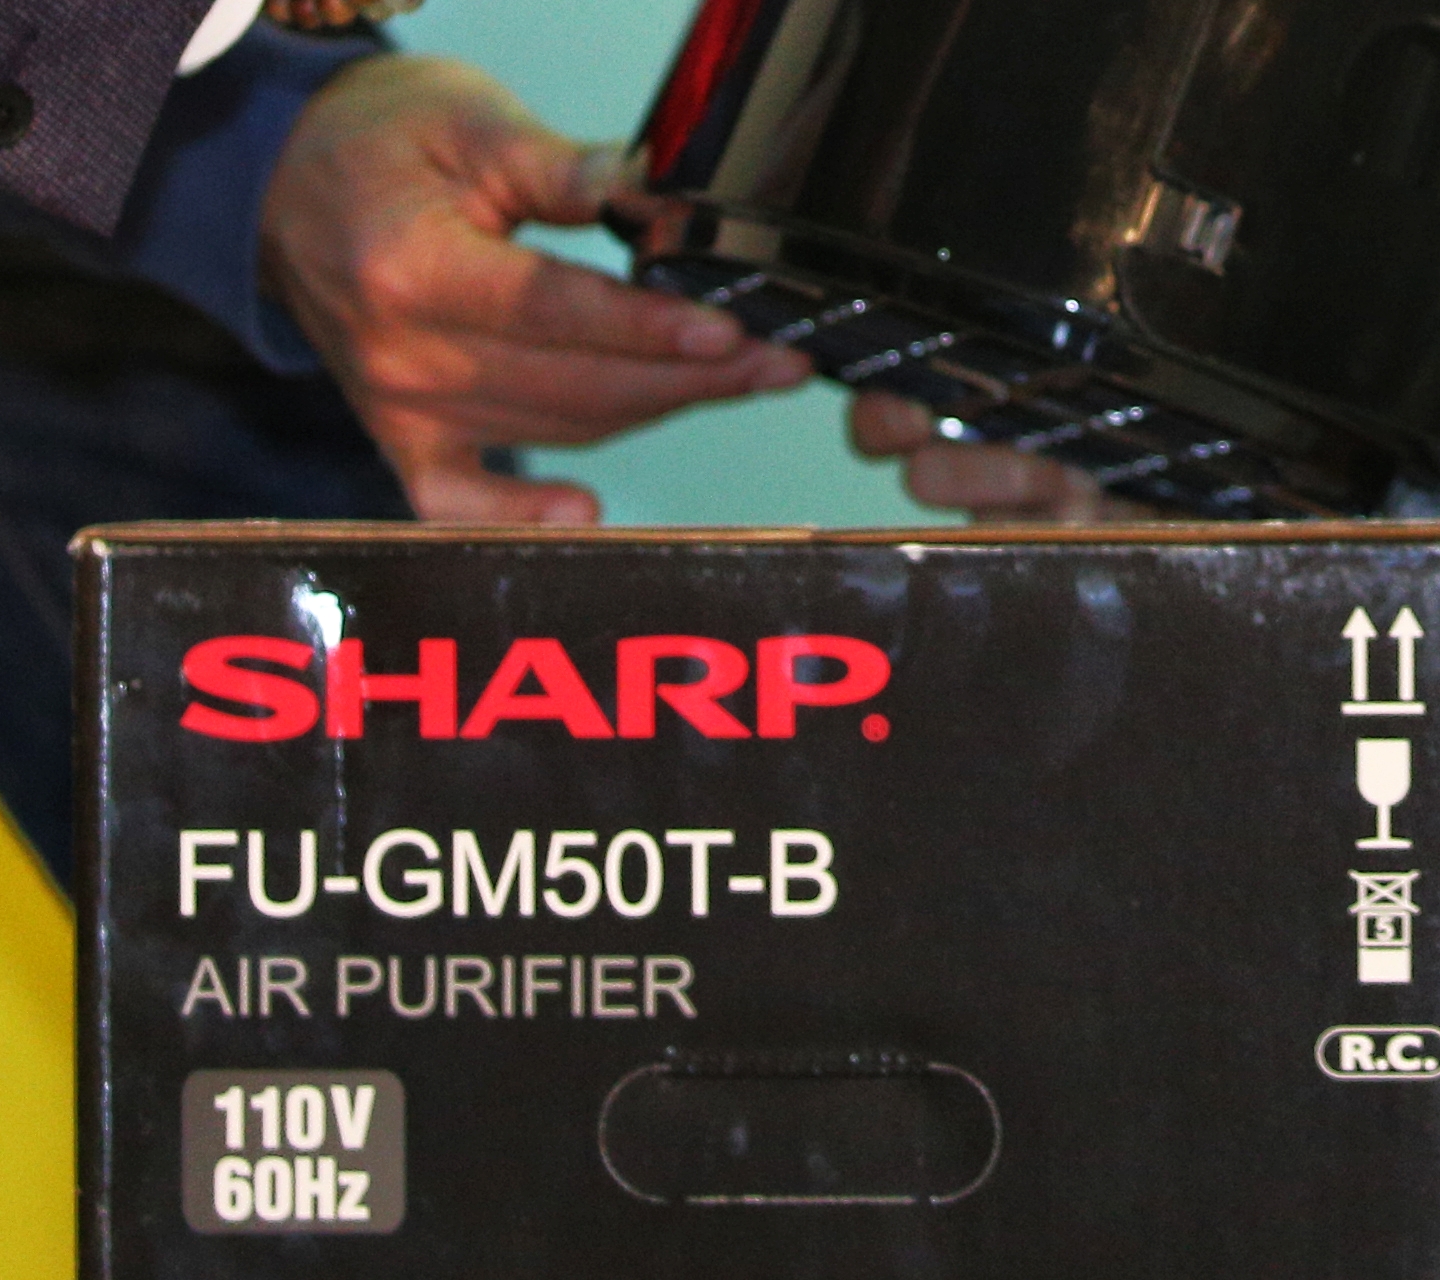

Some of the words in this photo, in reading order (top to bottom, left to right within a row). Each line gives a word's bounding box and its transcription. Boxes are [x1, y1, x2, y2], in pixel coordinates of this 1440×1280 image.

[179, 829, 839, 920] FU-GM50T-B
[181, 956, 312, 1018] AIR
[337, 956, 698, 1019] PURIFIER
[1339, 1033, 1439, 1073] R.C.
[213, 1085, 376, 1151] 110V
[213, 1156, 371, 1223] 60Hz
